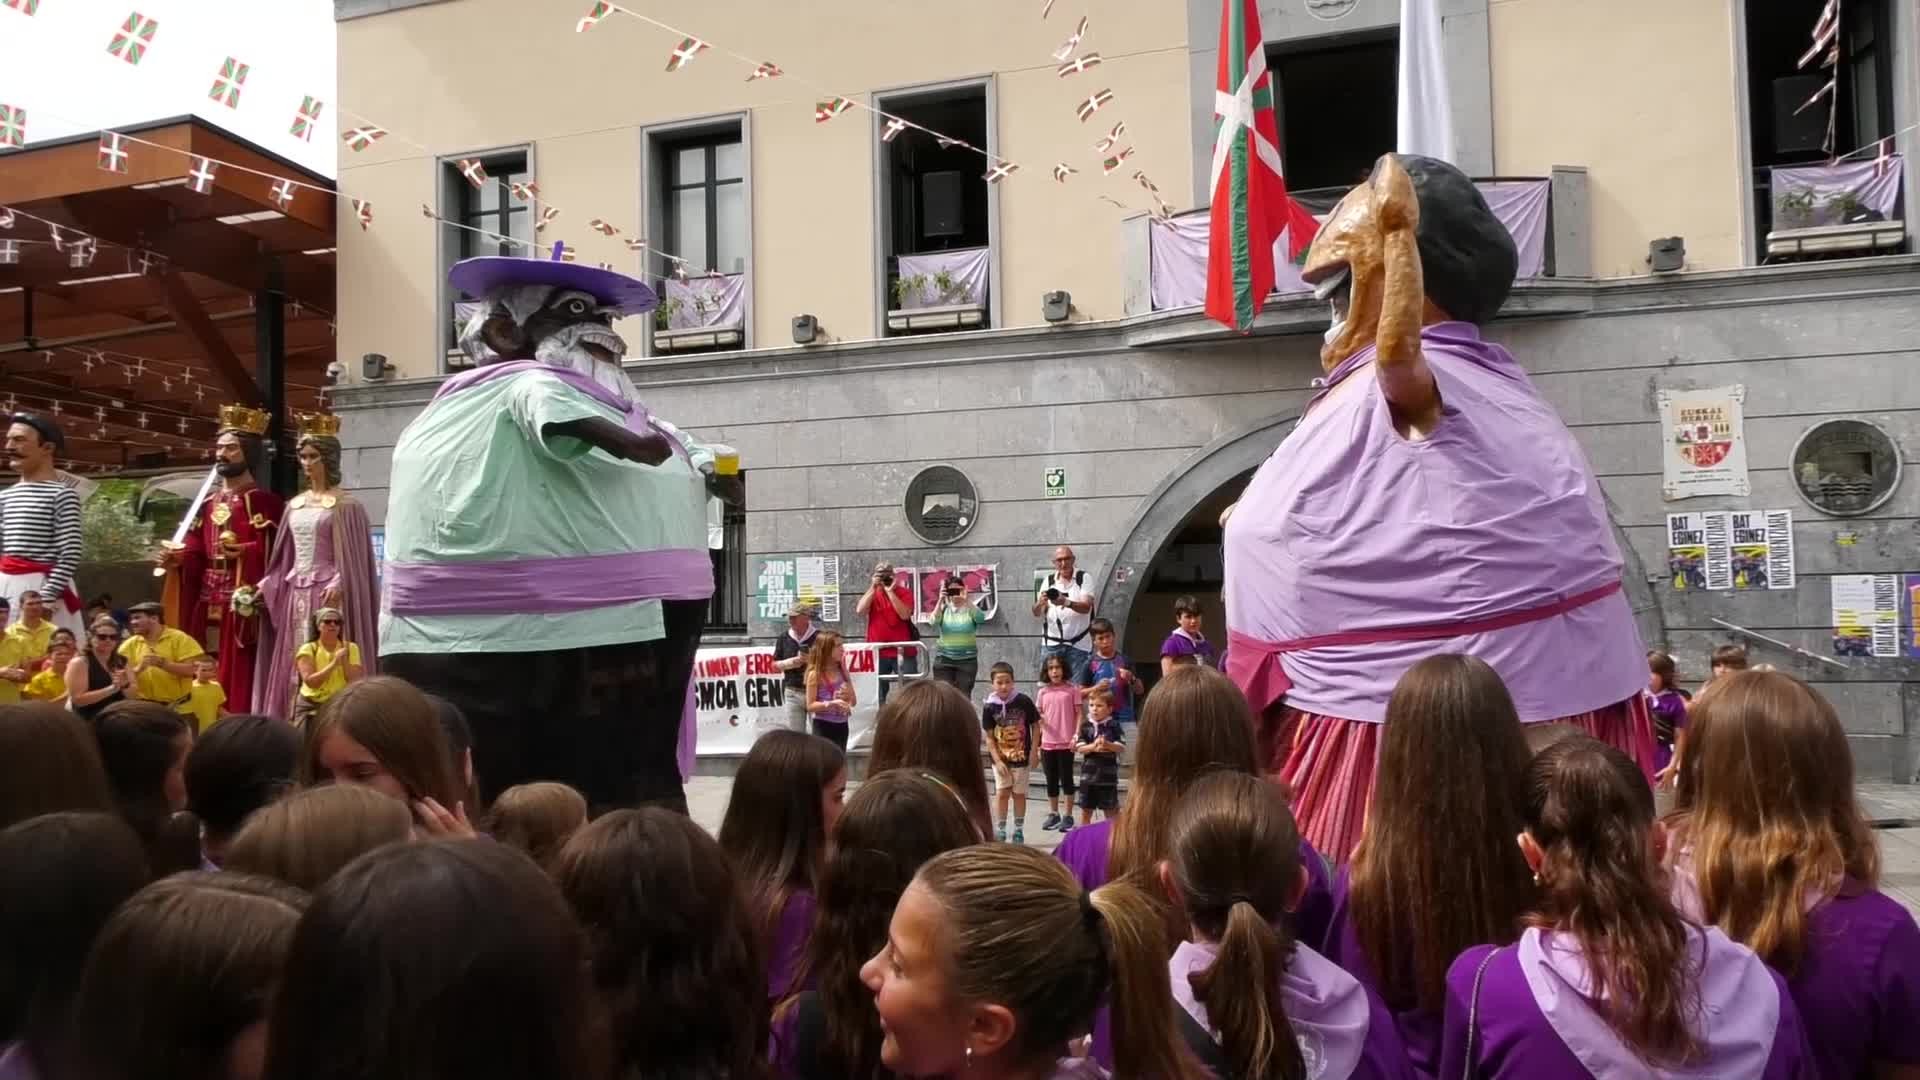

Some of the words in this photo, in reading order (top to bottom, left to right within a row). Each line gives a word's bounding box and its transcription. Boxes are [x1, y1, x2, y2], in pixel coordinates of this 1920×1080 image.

[1047, 489, 1064, 497] DEA
[1671, 516, 1688, 530] BAT
[1732, 514, 1751, 529] BAT
[1672, 530, 1704, 545] EGINEZ
[1733, 528, 1765, 543] EGINEZ
